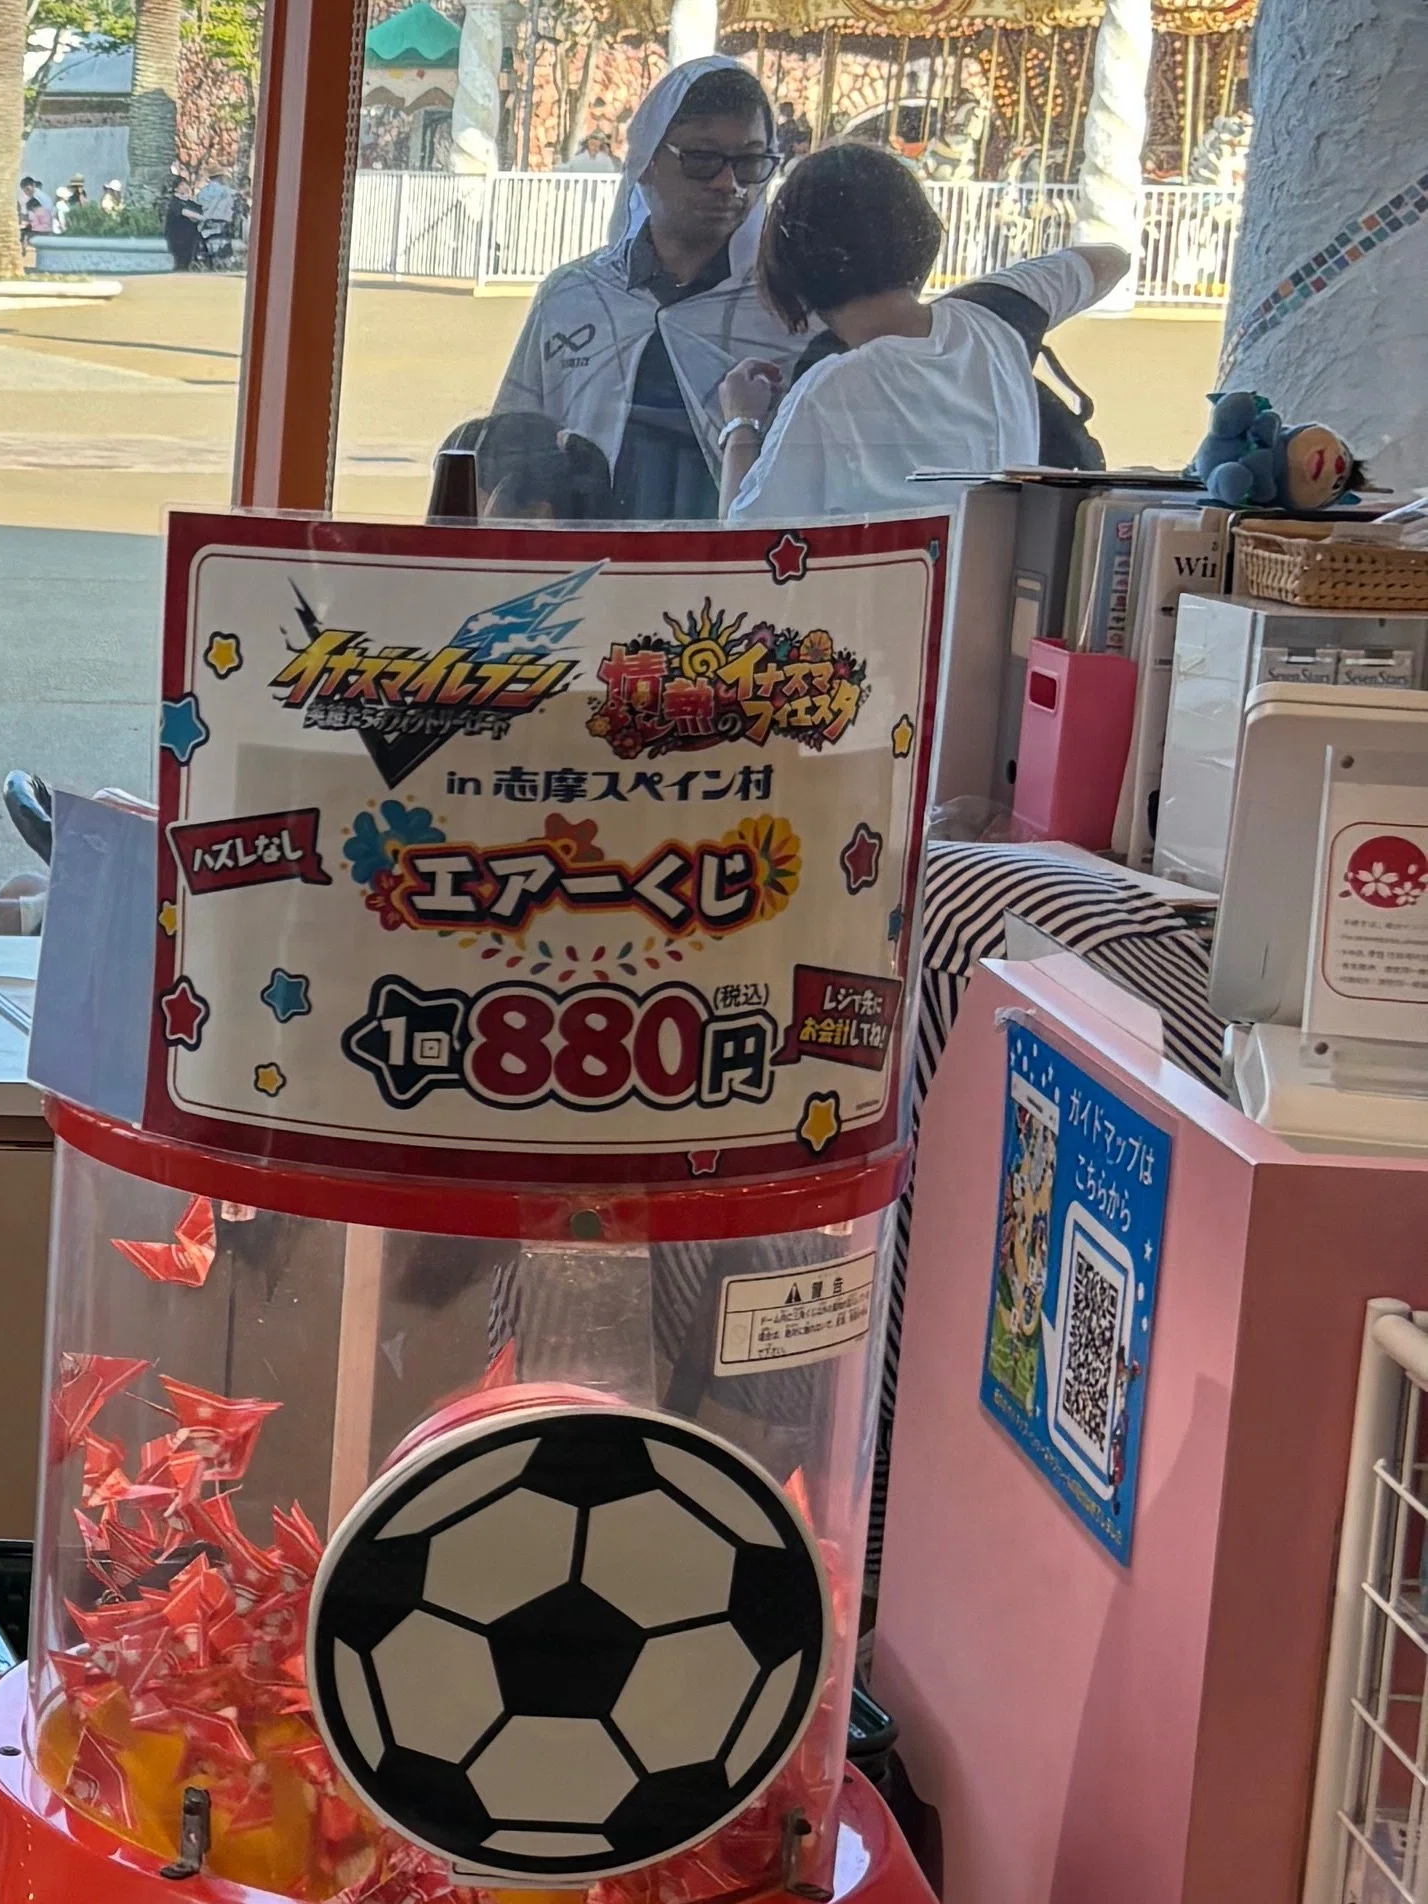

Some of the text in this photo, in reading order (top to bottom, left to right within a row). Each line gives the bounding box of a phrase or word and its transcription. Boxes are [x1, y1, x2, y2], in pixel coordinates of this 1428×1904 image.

[269, 629, 580, 711] イナズマイレブン
[447, 763, 775, 802] in 志摩スペイン村
[191, 833, 305, 874] ハズレなし
[409, 850, 753, 931] エアーくじ
[1068, 1087, 1155, 1185] ガイドマップは
[1075, 1153, 1132, 1232] こちらから
